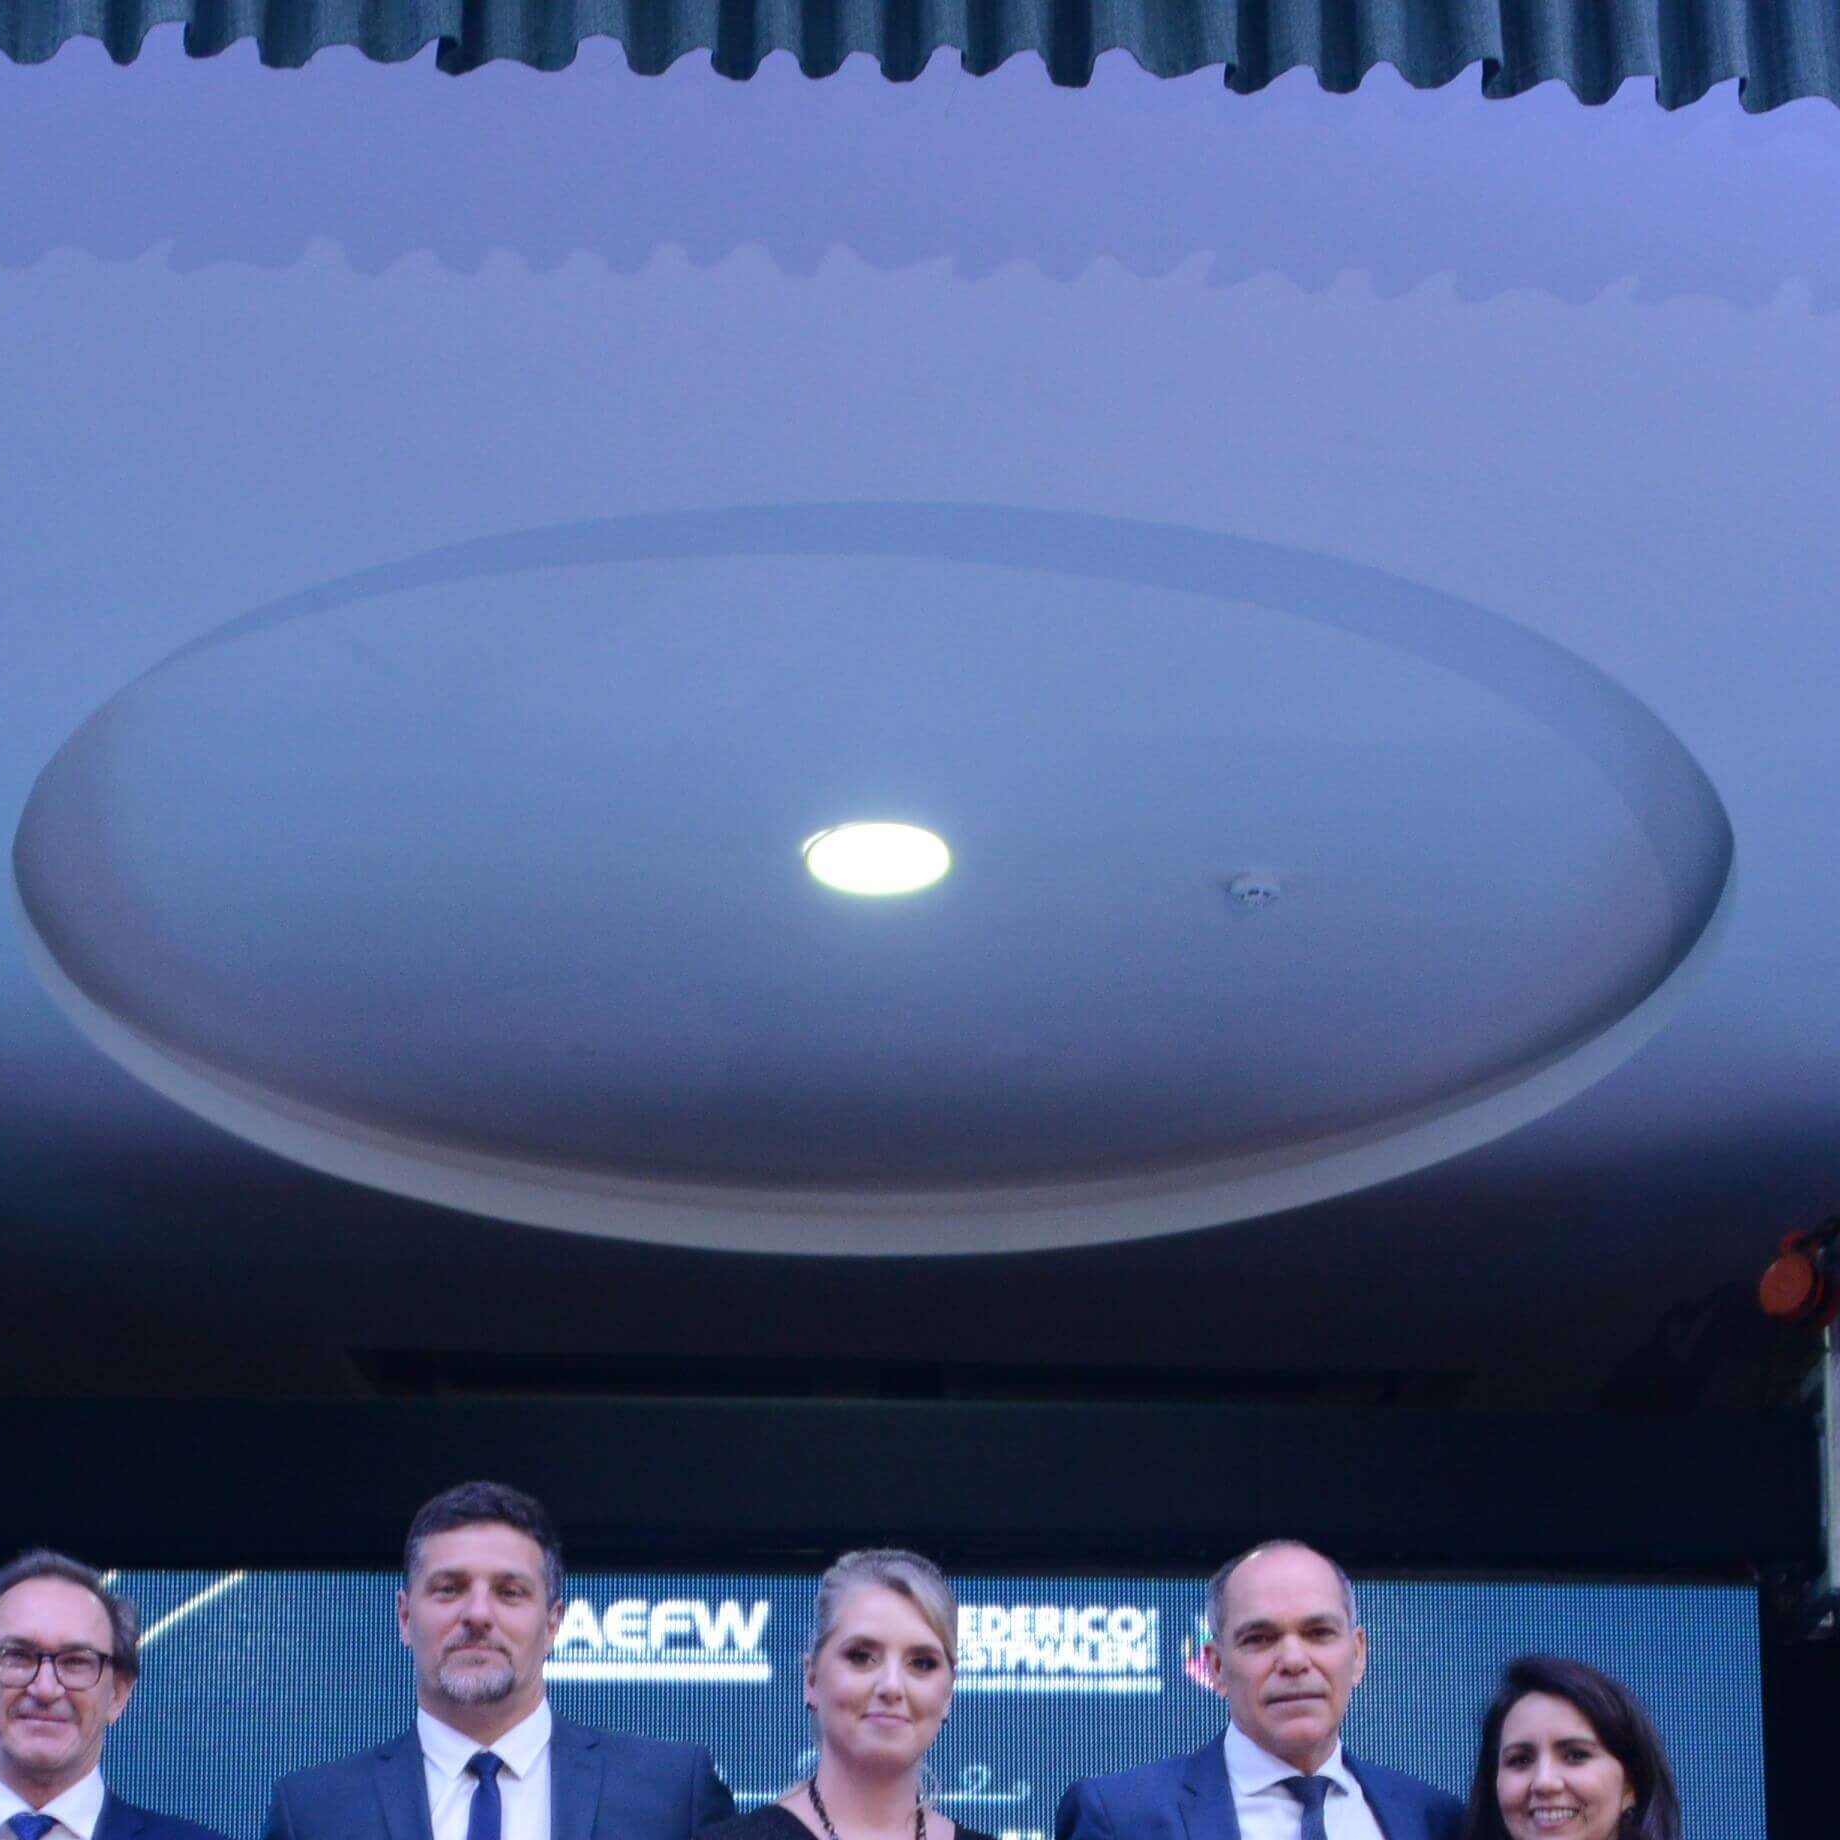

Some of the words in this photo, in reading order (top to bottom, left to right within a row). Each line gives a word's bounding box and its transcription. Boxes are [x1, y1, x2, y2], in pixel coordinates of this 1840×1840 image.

[553, 1597, 769, 1654] AEFW
[957, 1605, 1147, 1639] EDERICO
[957, 1638, 1148, 1672] STPHALEN
